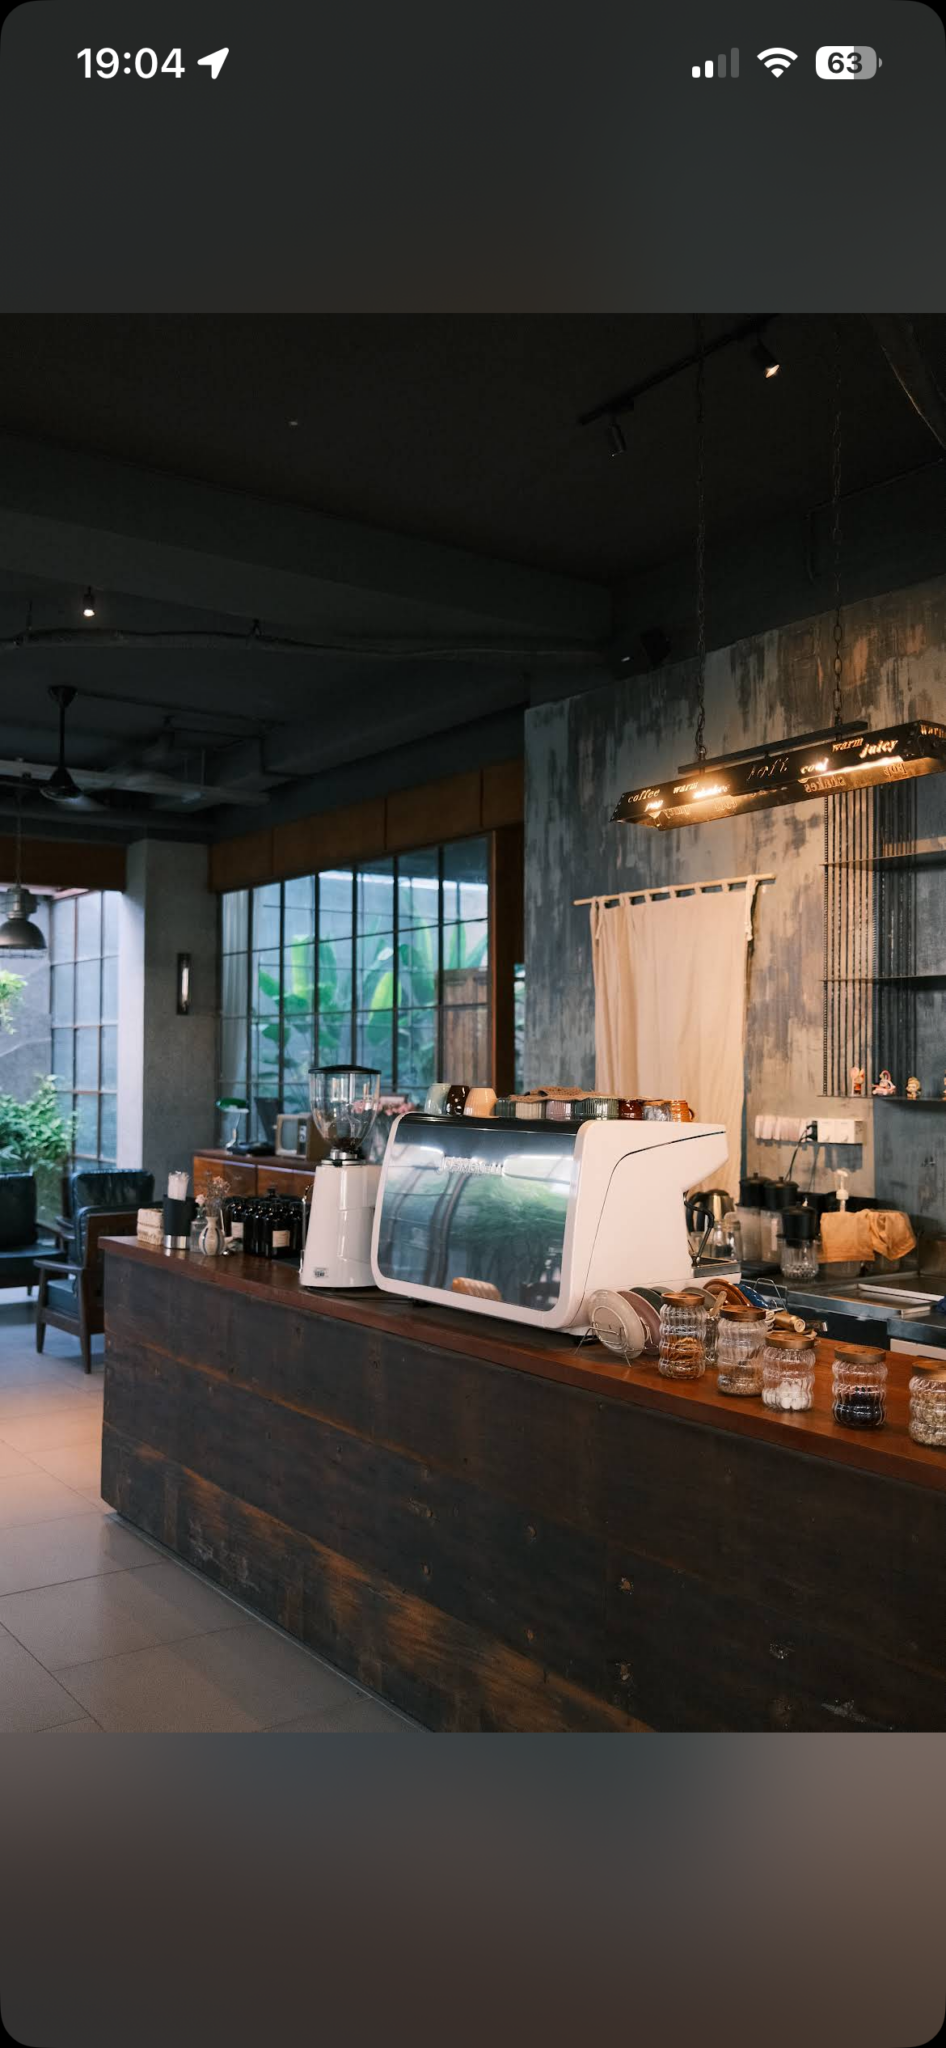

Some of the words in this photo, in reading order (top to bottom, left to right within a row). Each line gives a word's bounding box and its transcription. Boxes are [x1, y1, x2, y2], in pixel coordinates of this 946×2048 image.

[832, 737, 864, 752] warm
[859, 739, 899, 759] juicy
[627, 787, 661, 804] coffee
